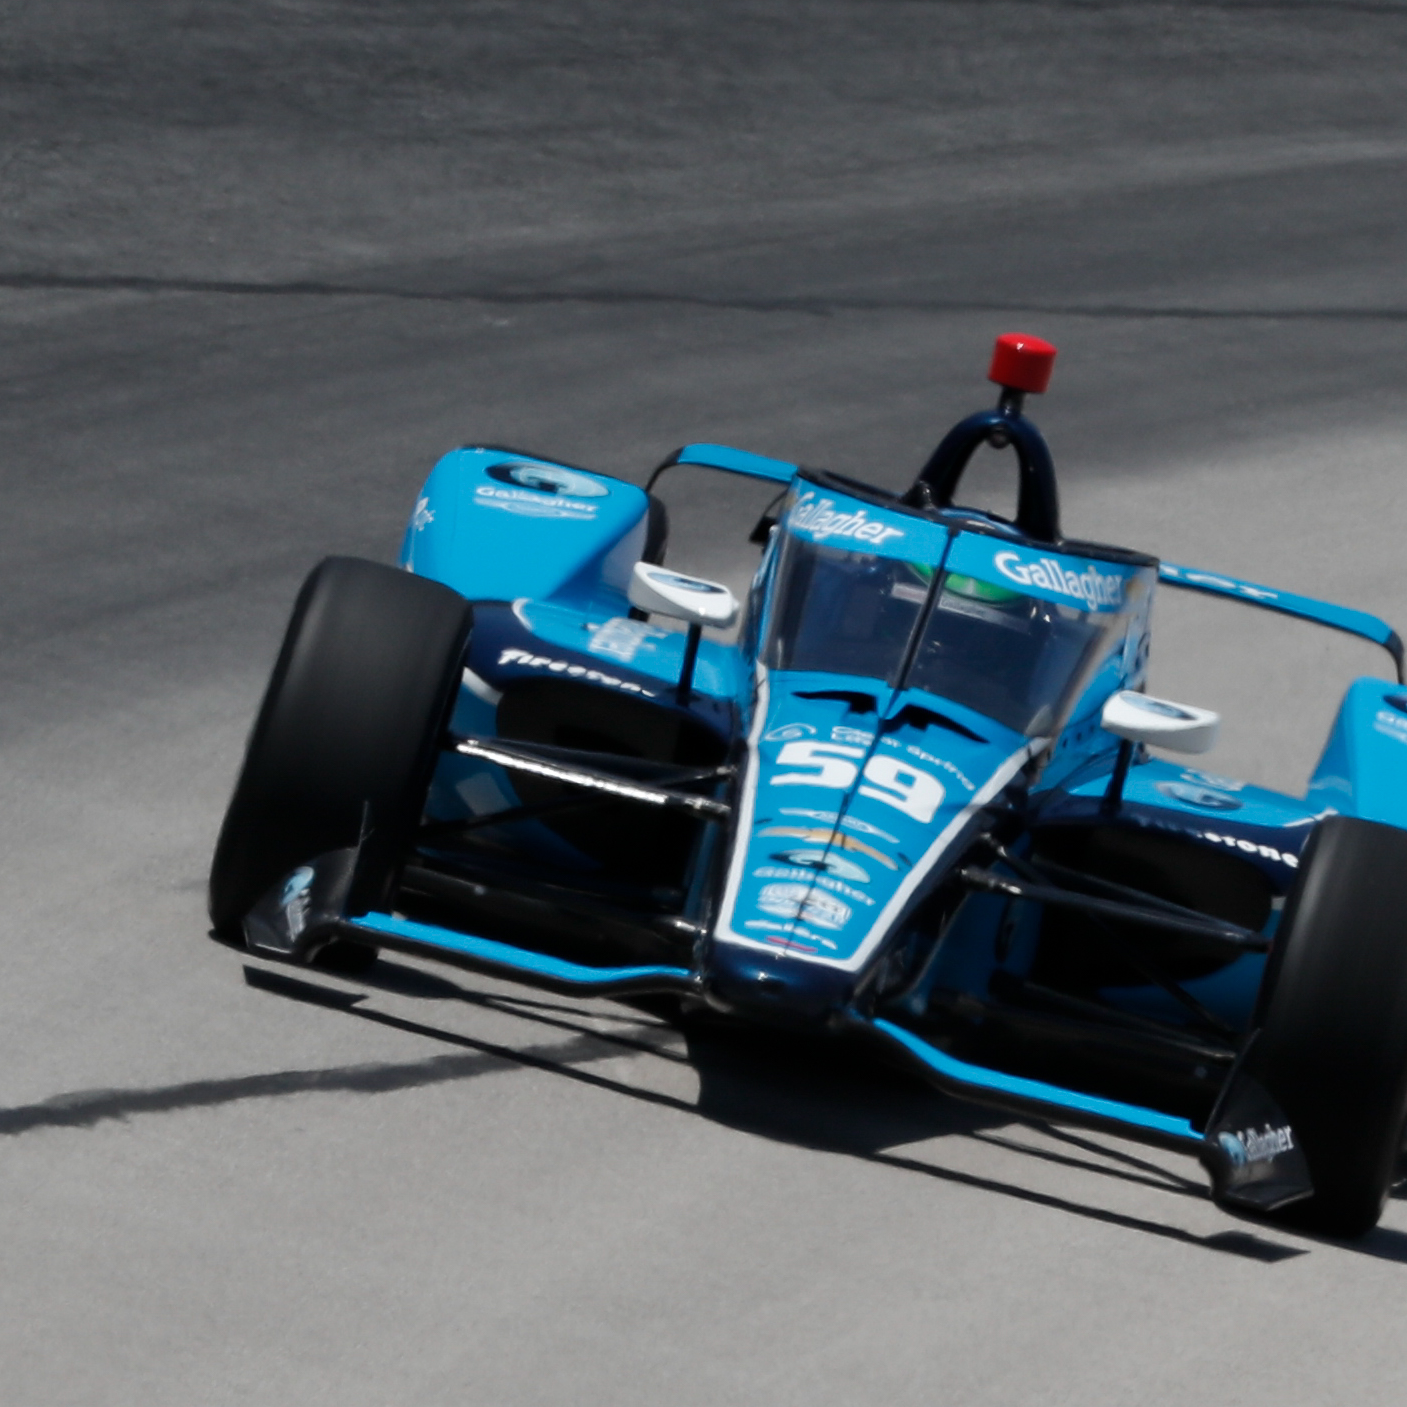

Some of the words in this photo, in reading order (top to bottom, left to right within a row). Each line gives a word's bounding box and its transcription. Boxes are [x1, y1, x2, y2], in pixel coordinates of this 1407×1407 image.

[788, 491, 904, 544] Gallagher
[995, 550, 1123, 611] Gallagher
[769, 740, 946, 824] 59
